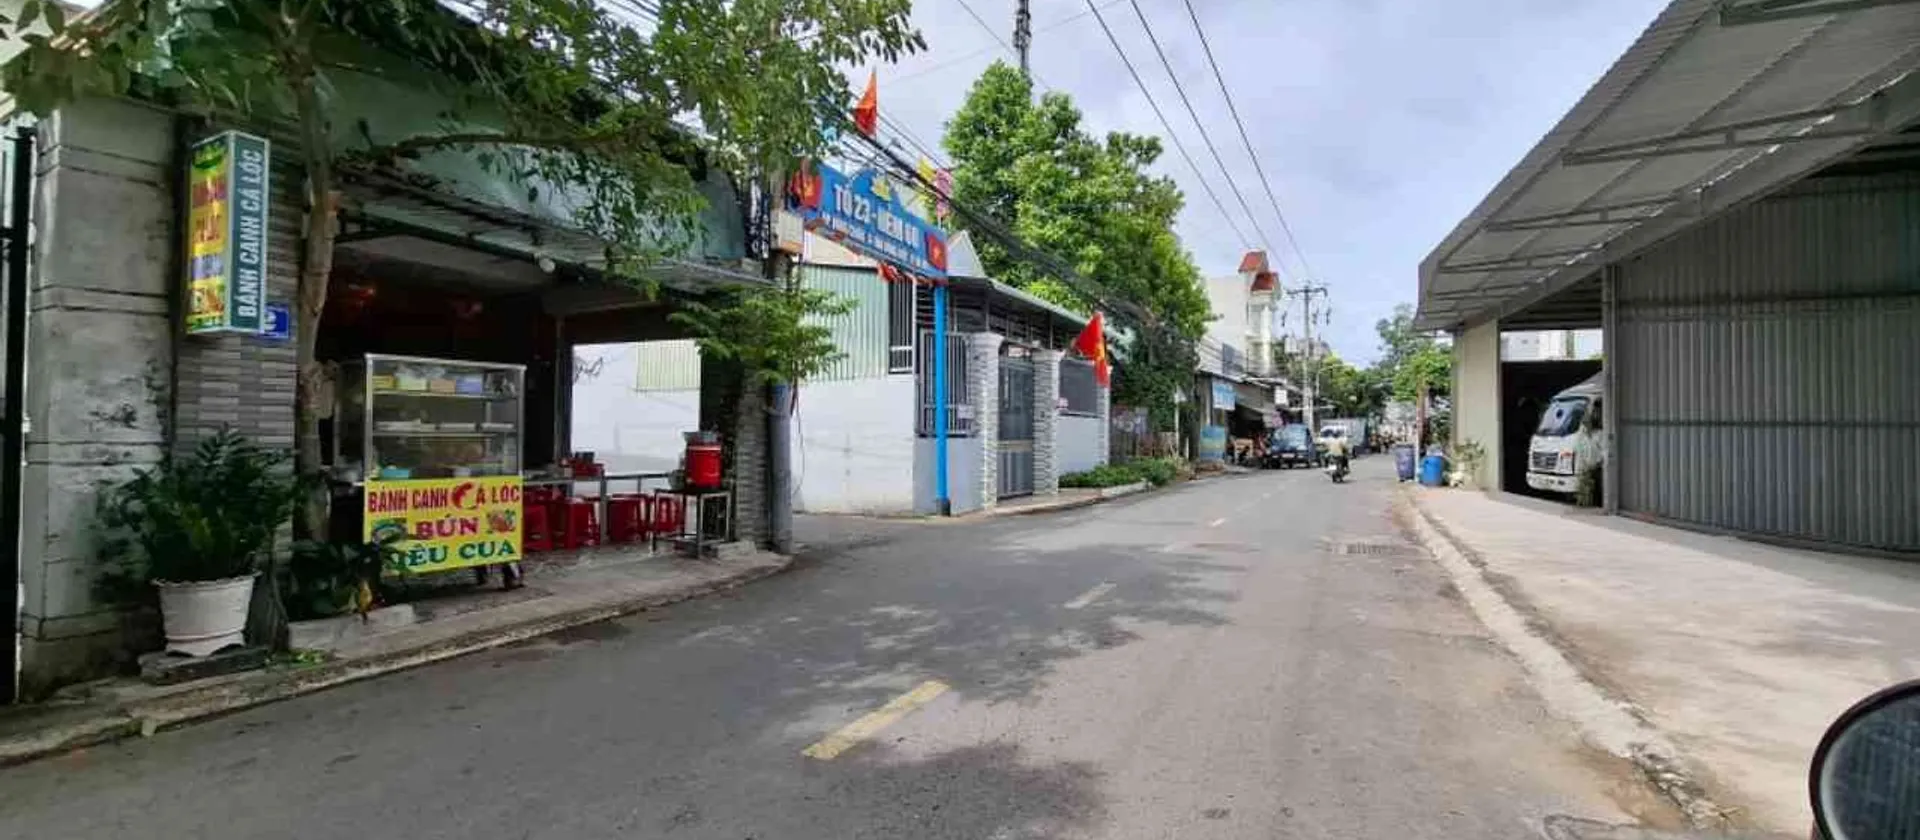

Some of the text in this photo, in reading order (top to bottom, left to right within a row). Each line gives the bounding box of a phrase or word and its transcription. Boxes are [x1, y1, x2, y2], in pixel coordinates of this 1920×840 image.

[237, 188, 261, 212] CÁ
[240, 216, 261, 265] CANH
[234, 269, 260, 318] BÁNH
[368, 486, 408, 513] BÁNH
[412, 487, 449, 510] CANH
[491, 482, 520, 504] LÓC
[415, 513, 479, 541] BÚN
[458, 539, 516, 560] CUA
